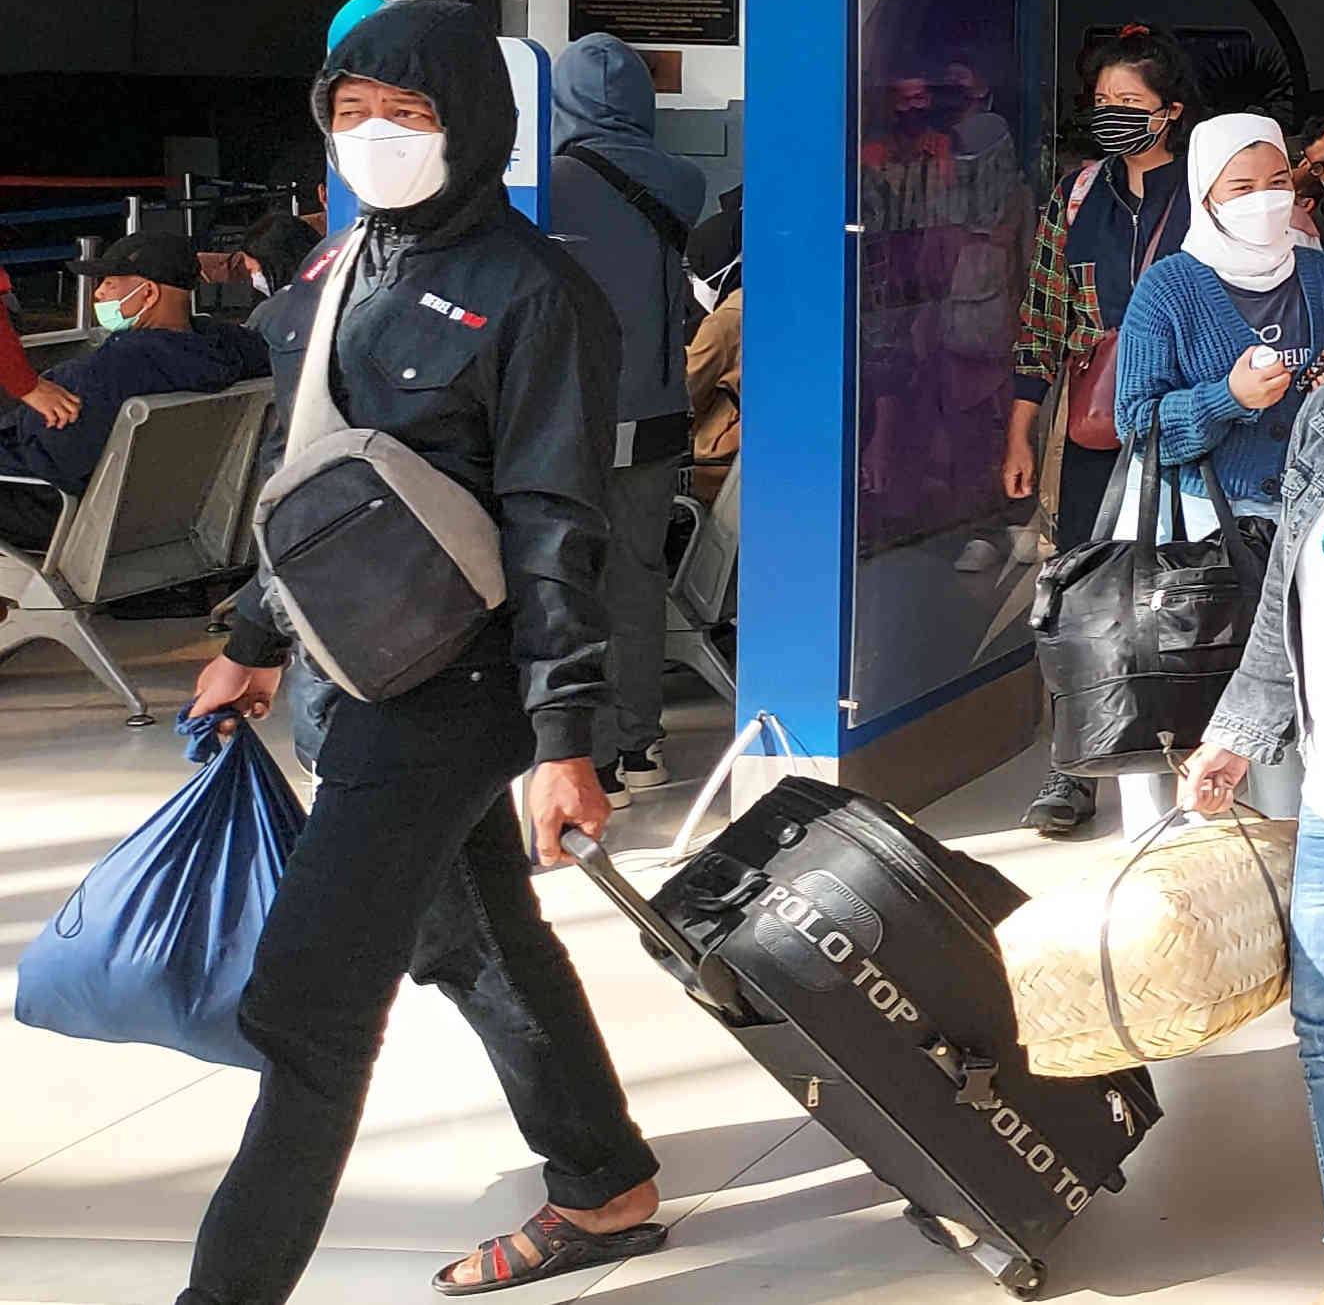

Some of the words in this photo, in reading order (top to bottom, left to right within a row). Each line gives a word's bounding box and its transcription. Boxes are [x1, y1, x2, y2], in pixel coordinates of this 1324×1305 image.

[759, 885, 854, 963] POLO
[852, 958, 919, 1023] TOP
[1054, 1166, 1093, 1217] TO
